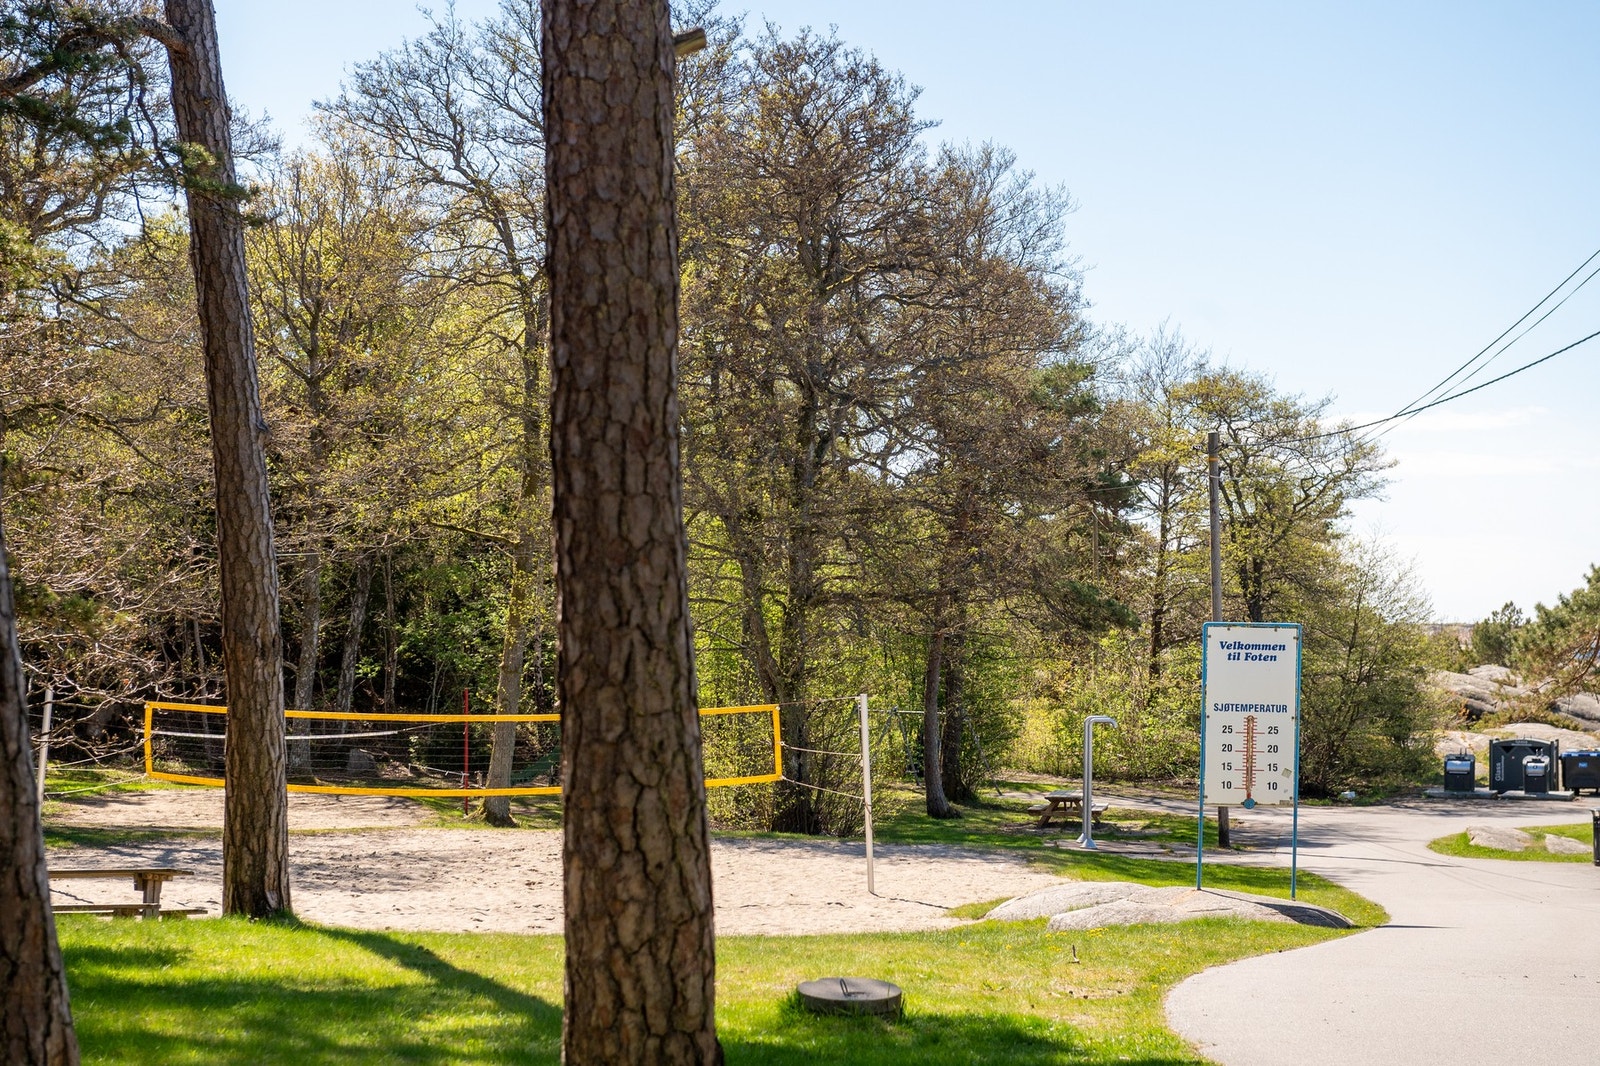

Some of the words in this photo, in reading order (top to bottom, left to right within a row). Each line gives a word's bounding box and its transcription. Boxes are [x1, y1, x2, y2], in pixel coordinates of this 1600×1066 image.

[1219, 641, 1286, 651] Velkommen
[1227, 652, 1241, 661] til
[1244, 652, 1277, 662] Foten
[1213, 703, 1288, 713] SJØTEMPERATUR
[1222, 725, 1233, 734] 25
[1268, 726, 1279, 735] 25
[1222, 744, 1233, 752] 20
[1267, 744, 1279, 753] 20
[1221, 762, 1232, 771] 15
[1268, 763, 1278, 772] 15
[1221, 781, 1232, 789] 10
[1267, 782, 1278, 790] 10
